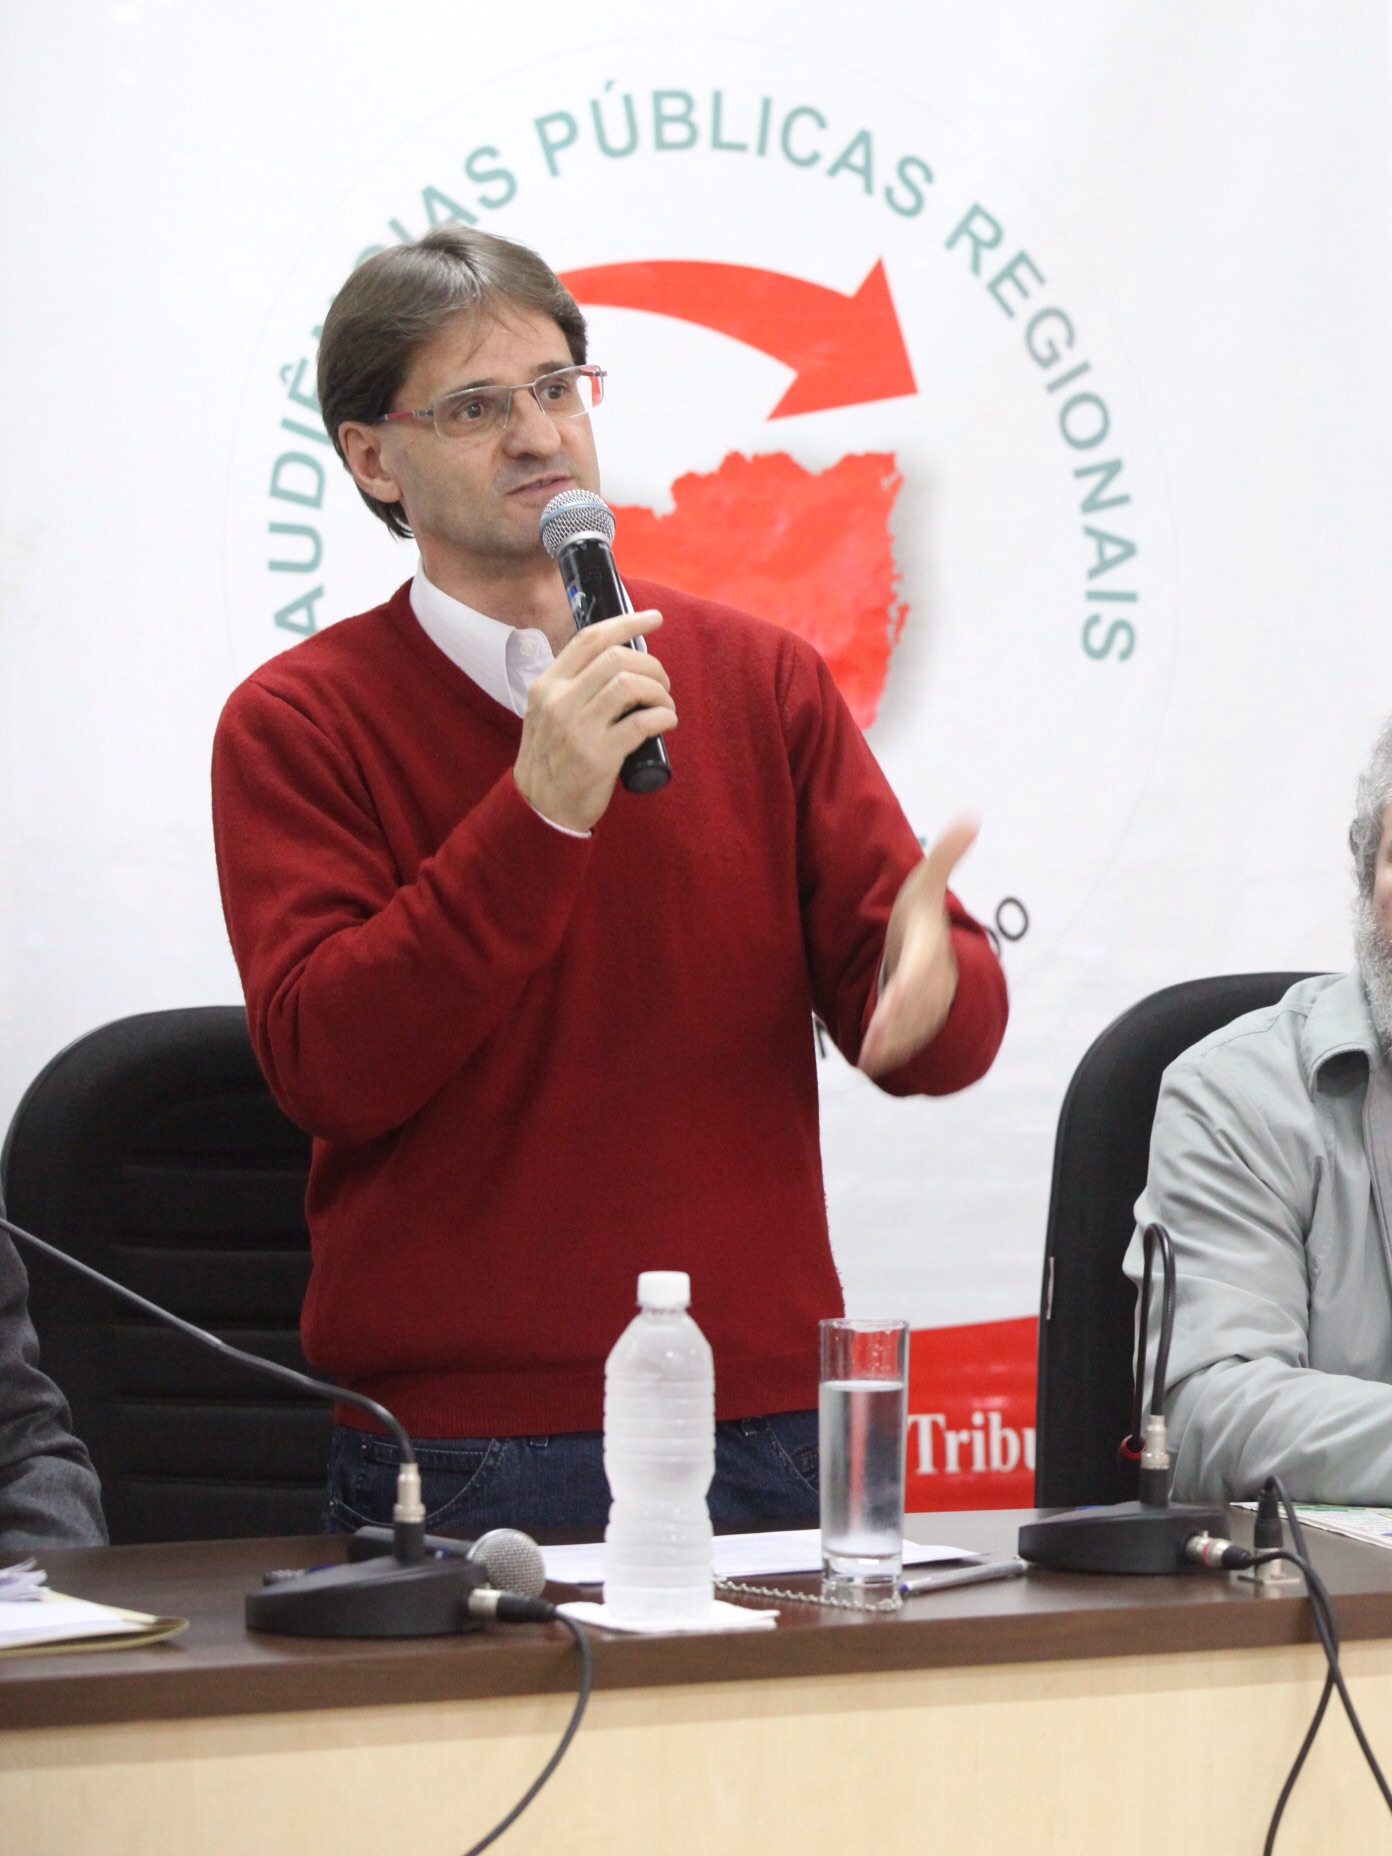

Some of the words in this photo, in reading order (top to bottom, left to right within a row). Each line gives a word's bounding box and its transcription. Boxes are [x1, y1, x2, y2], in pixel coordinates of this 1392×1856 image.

[267, 144, 518, 637] AUDIÊIAS
[533, 79, 935, 218] PÚBLICAS
[943, 201, 1139, 663] REGIONAIS
